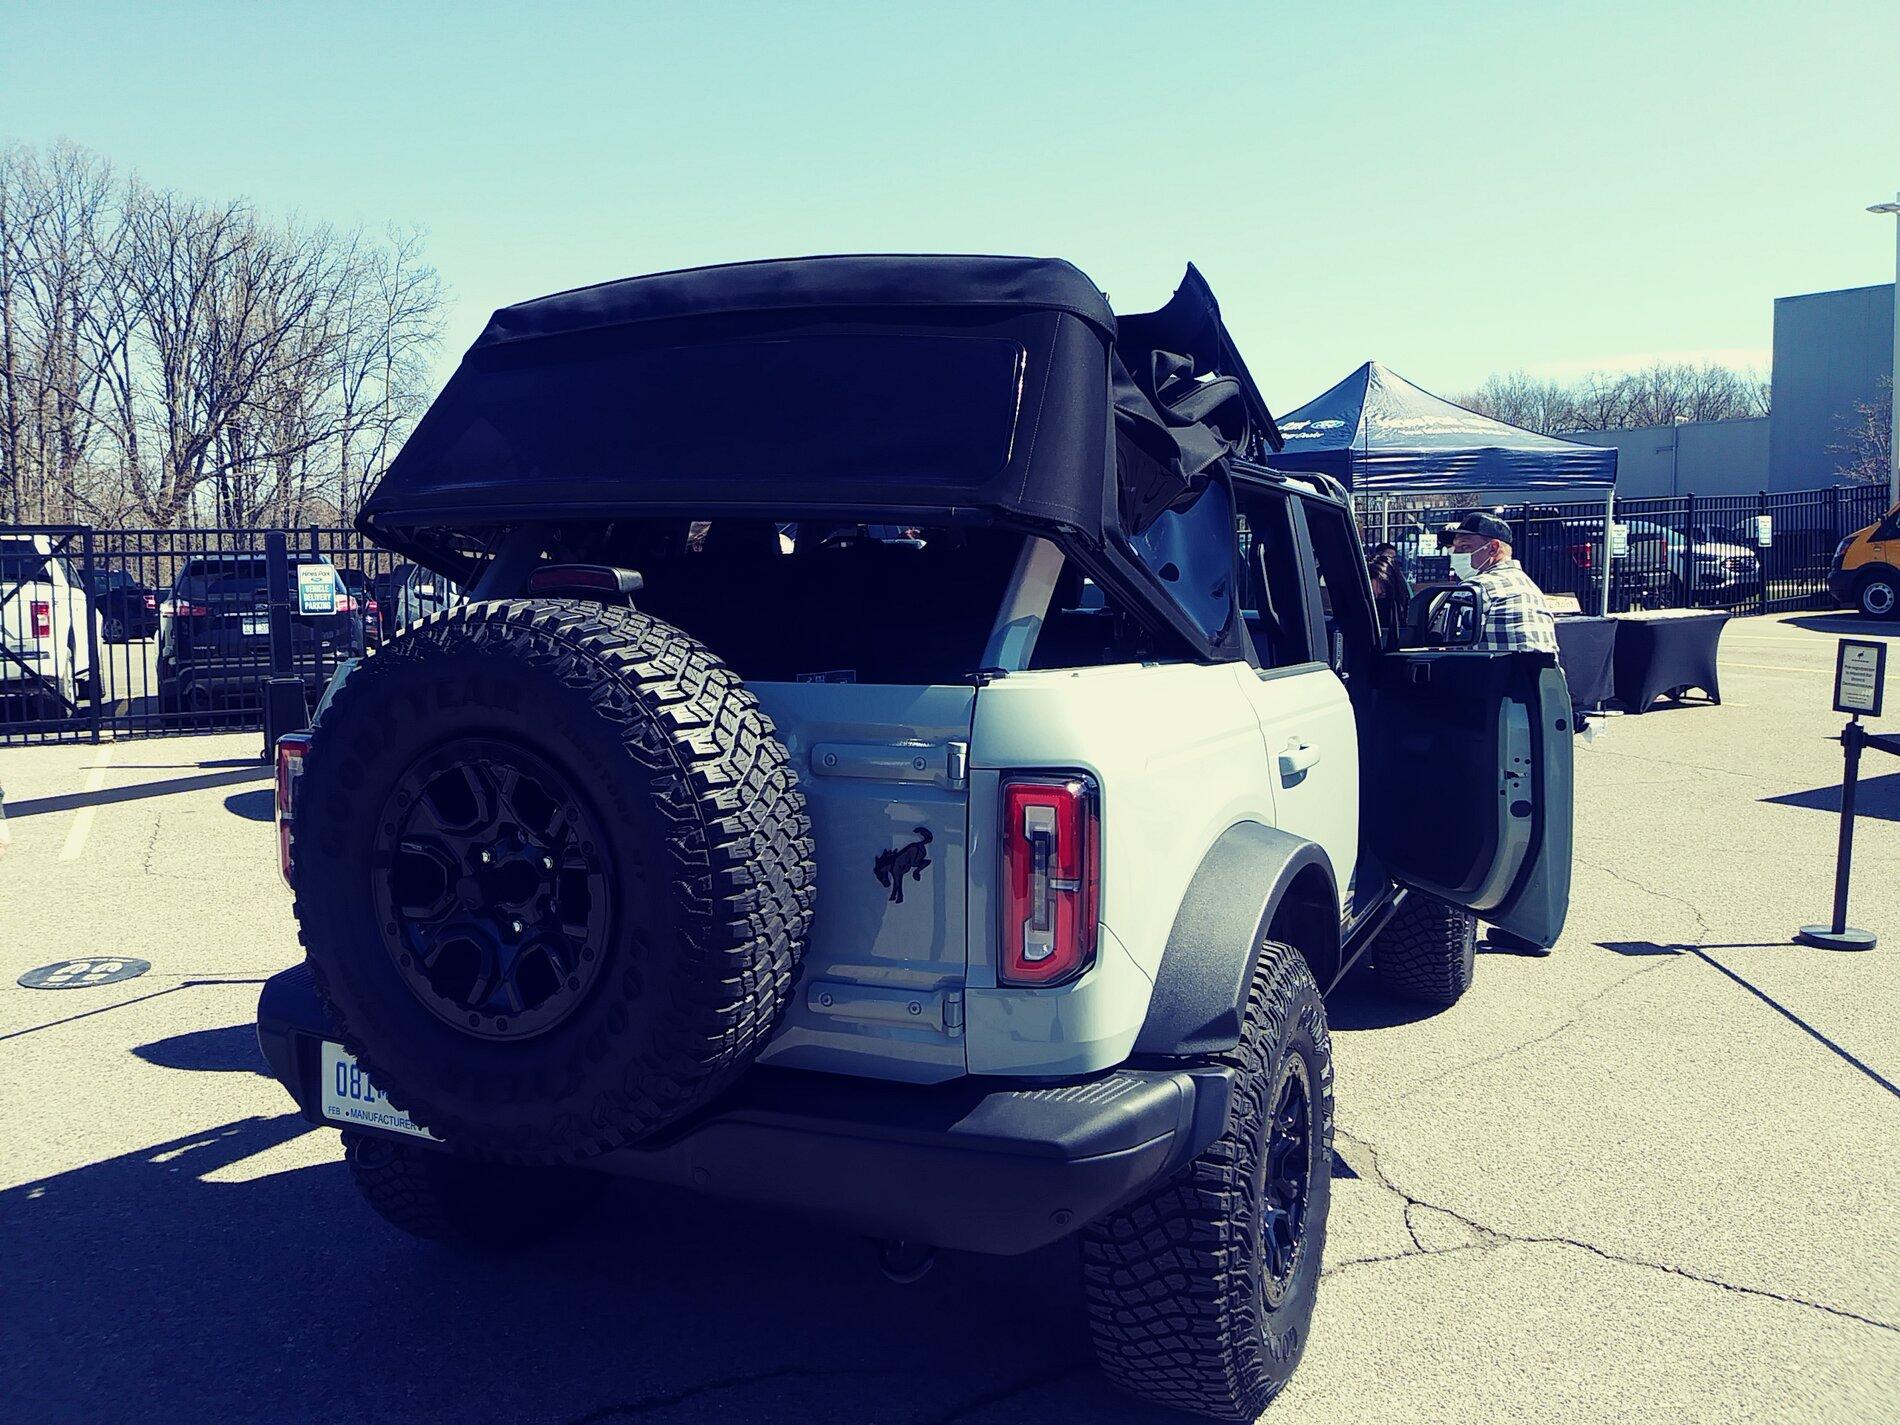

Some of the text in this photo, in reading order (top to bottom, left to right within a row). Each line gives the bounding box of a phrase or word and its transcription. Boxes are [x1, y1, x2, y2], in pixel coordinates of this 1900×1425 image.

[304, 584, 330, 592] VEHICLE
[303, 593, 331, 601] DELIVERY
[304, 601, 331, 609] PARKING
[328, 1105, 417, 1131] FEB MANUFACTURER
